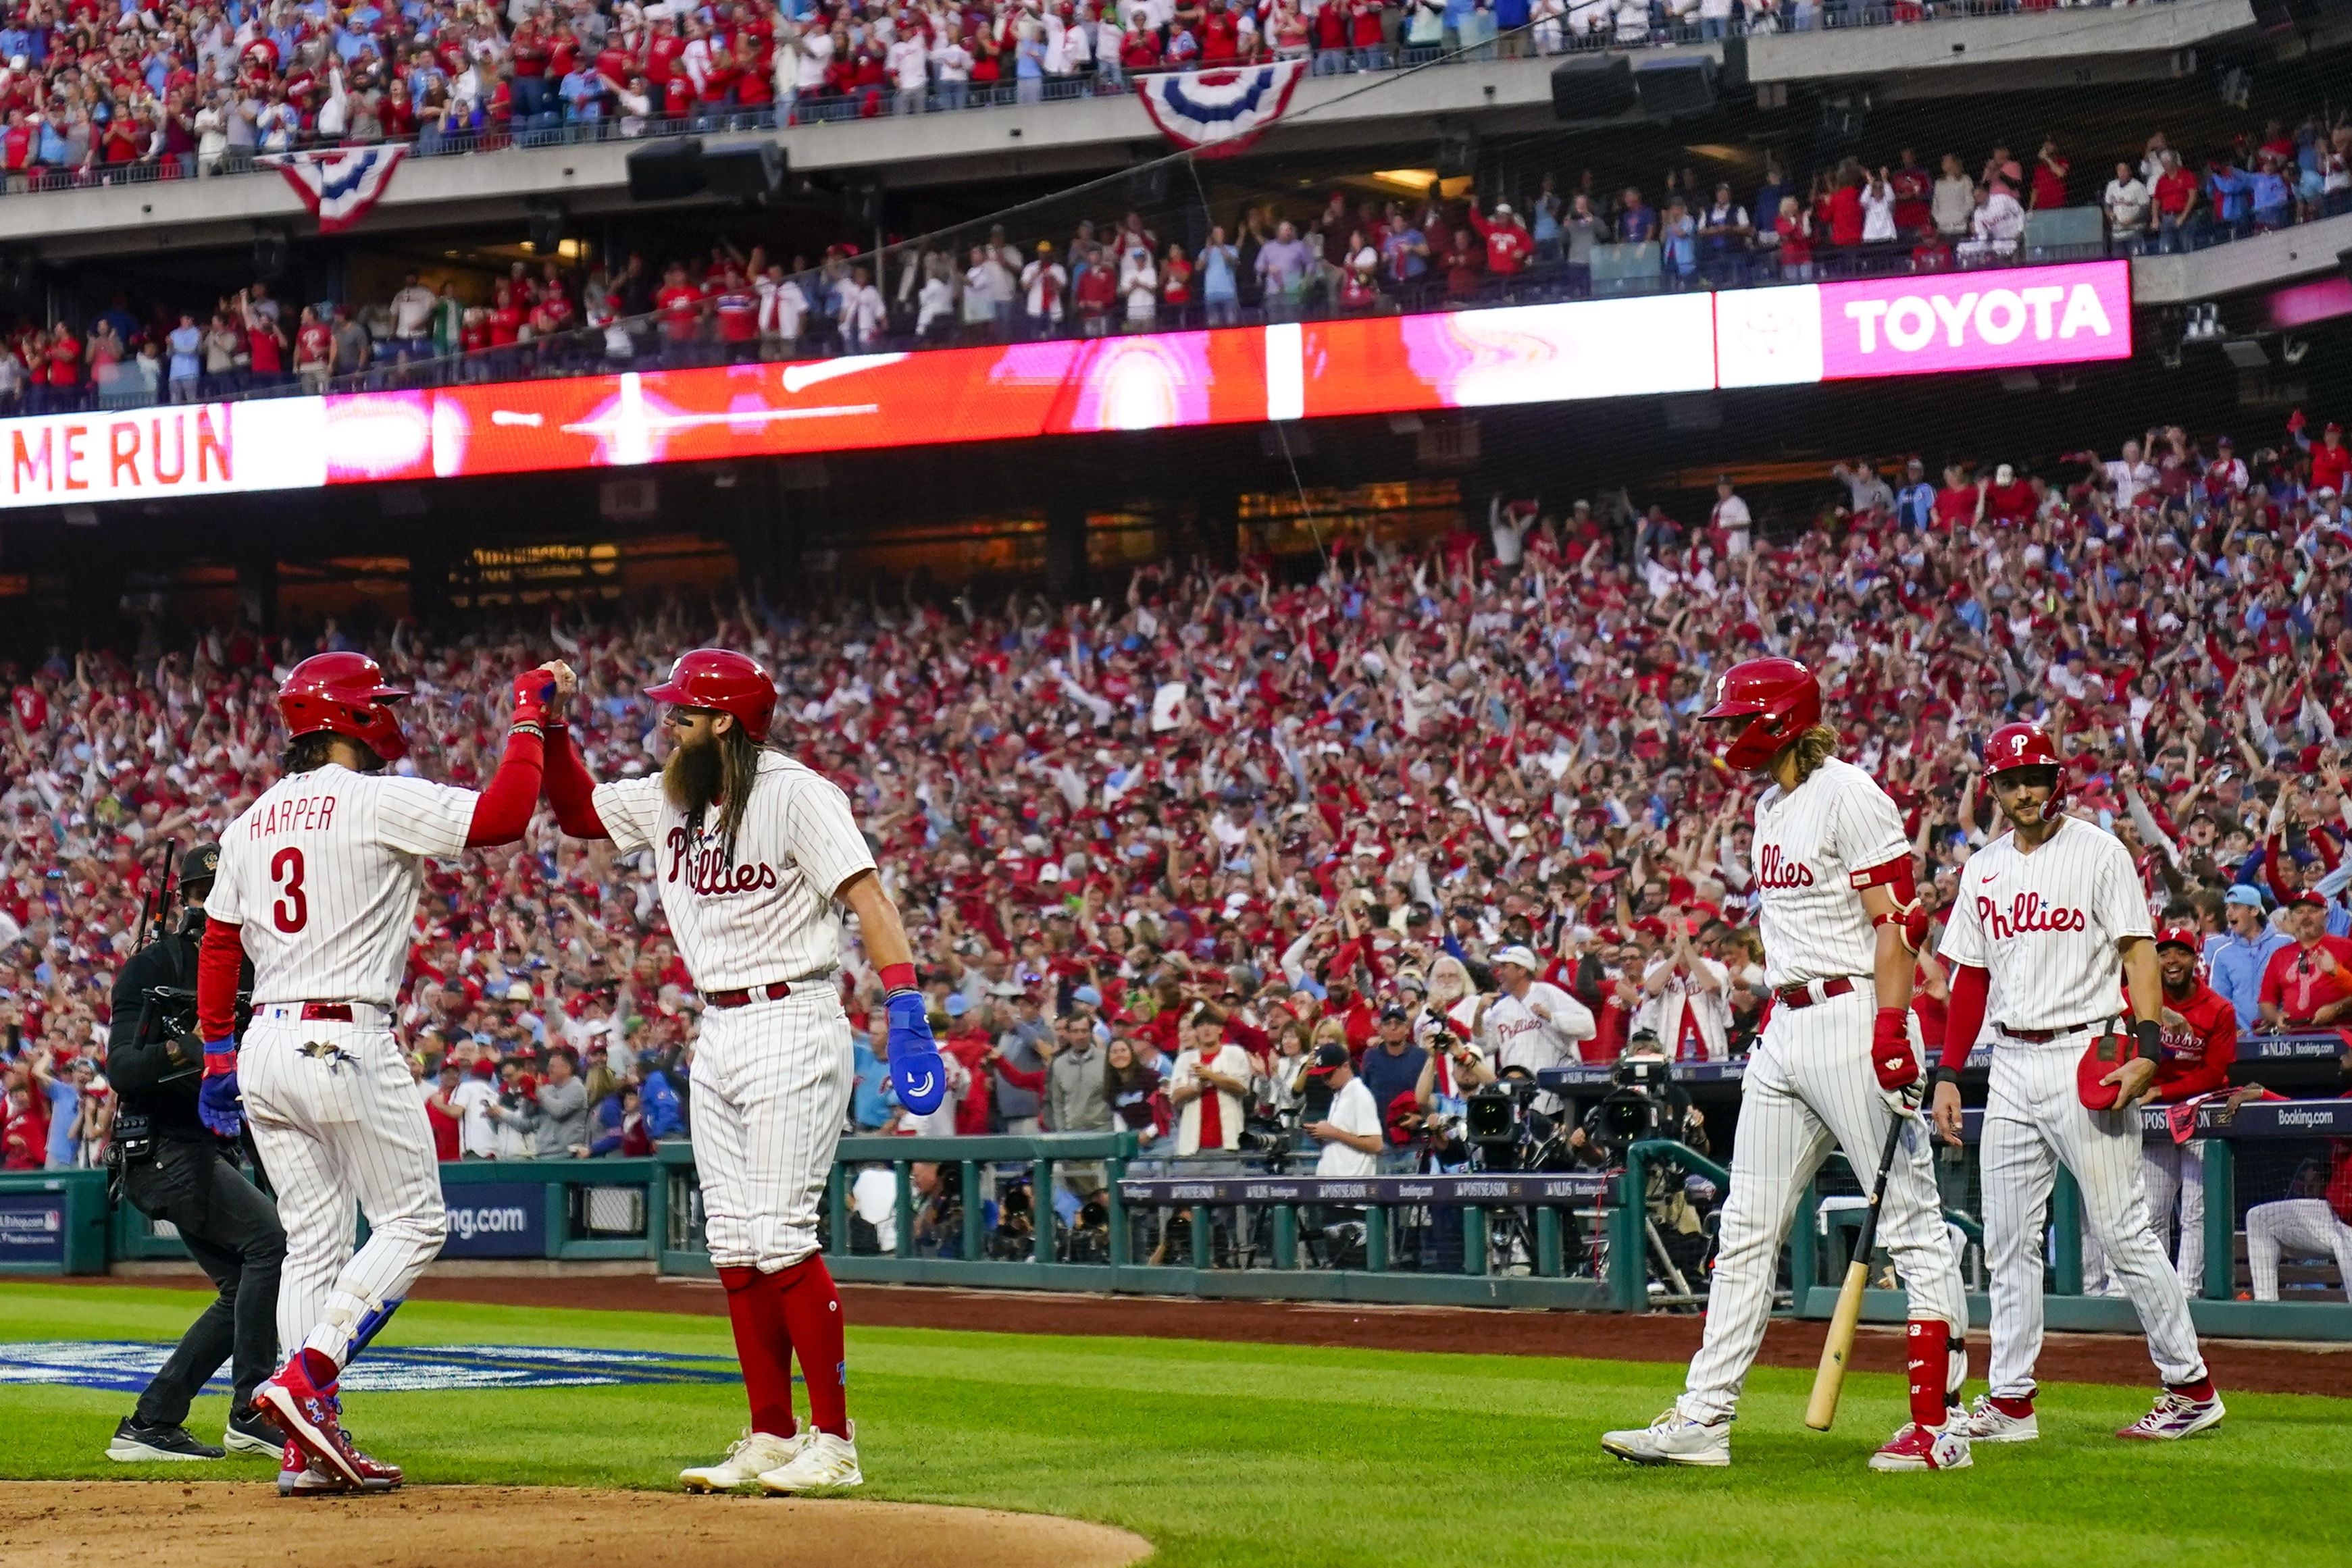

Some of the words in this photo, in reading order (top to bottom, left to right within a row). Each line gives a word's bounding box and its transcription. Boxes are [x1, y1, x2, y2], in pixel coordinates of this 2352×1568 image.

[1845, 283, 2112, 354] TOYOTA
[0, 425, 89, 494] ME
[109, 401, 234, 487] RUN
[2011, 734, 2028, 756] P
[250, 795, 336, 841] HARPER
[667, 826, 777, 896] Phillies
[1756, 843, 1814, 890] llies
[271, 846, 308, 934] 3
[1976, 891, 2085, 943] Phillies
[2169, 927, 2180, 939] P
[1497, 1018, 1543, 1043] Phillies
[2270, 1043, 2292, 1056] NLDS
[2296, 1041, 2334, 1057] Booking.com
[2278, 1109, 2333, 1128] Booking.com
[1399, 1184, 1433, 1200] Booking.com
[1462, 1182, 1508, 1197] POSTSEASON
[1553, 1182, 1571, 1196] NLDS
[286, 1447, 295, 1467] 3
